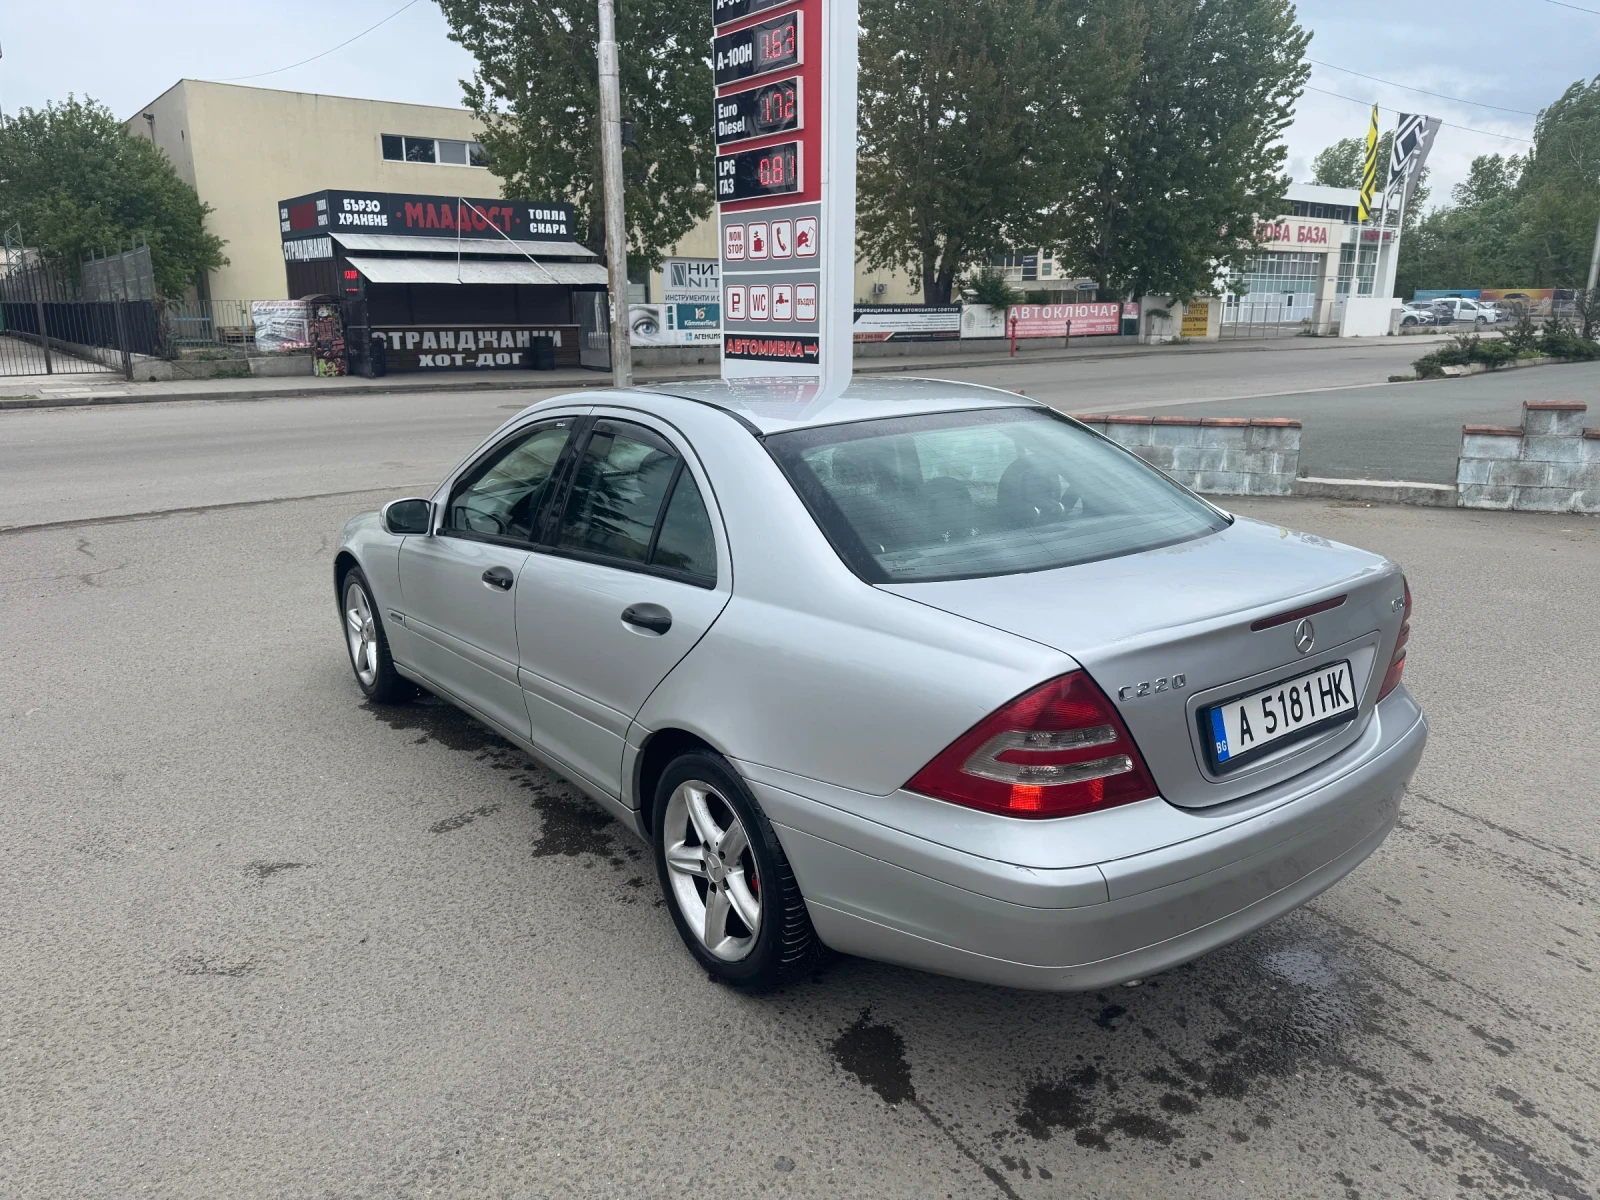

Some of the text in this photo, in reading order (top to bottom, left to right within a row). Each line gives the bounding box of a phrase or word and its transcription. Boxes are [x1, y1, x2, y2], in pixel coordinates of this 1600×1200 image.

[765, 25, 795, 59] 1.63
[718, 103, 738, 120] Euro
[765, 89, 795, 123] 1.72
[718, 116, 745, 137] Diesel
[719, 155, 795, 186] LPG 0.81
[719, 178, 735, 195] ГАЗ
[343, 198, 381, 213] БЪРЗО
[338, 213, 389, 227] ХРАНЕНЕ
[404, 201, 514, 233] МЛАДОСТ
[528, 208, 567, 222] ТОПЛА
[529, 222, 567, 235] СКАРА
[729, 231, 742, 242] NON
[1297, 225, 1327, 244] БАЗА
[284, 236, 333, 262] СТРАНДЖАНКИ
[728, 244, 743, 255] STOP
[665, 294, 709, 302] ИНСТРУМЕНТИ
[752, 294, 766, 312] WC
[1009, 304, 1119, 319] АВТОКЛЮЧАР
[371, 330, 562, 352] СТРАНДЖАНИ
[726, 338, 804, 358] АВТОМИВКА
[418, 352, 523, 368] ХОТ-ДОГ
[1239, 705, 1255, 746] A
[1216, 740, 1228, 755] BG
